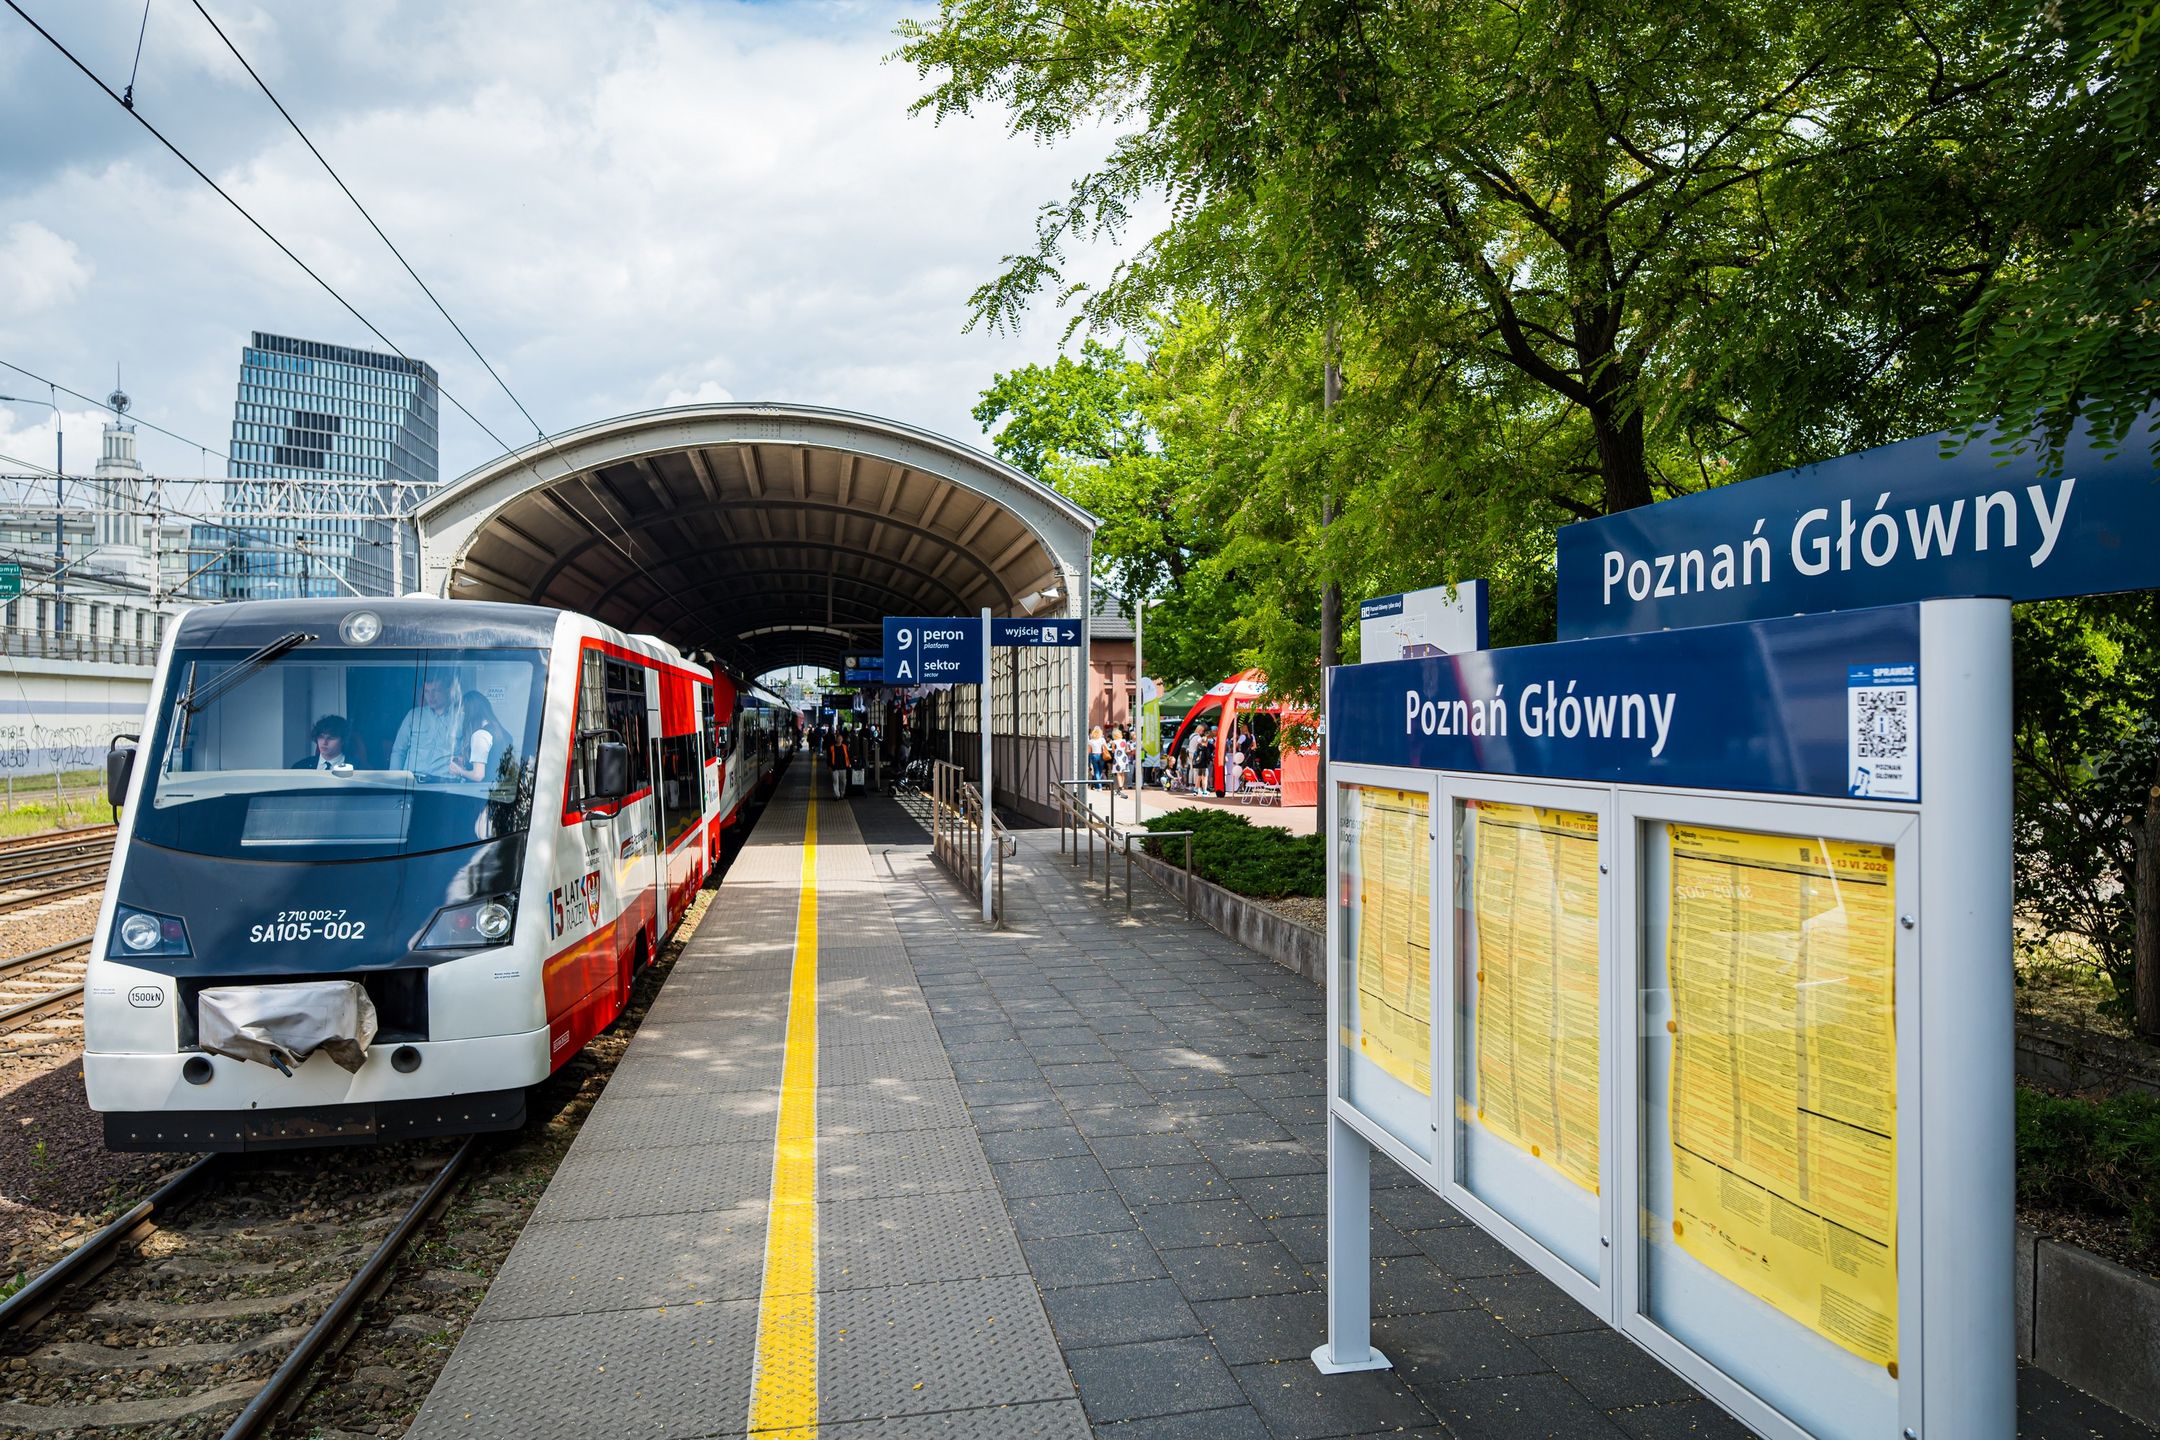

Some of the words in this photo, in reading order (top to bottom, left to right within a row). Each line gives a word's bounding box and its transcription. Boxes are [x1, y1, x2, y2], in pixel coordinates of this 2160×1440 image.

[1603, 517, 1771, 605] Poznań
[1790, 477, 2076, 577] Główny
[896, 628, 913, 650] 9
[923, 629, 964, 643] peron
[1005, 626, 1039, 638] wyjście
[923, 642, 950, 650] platform
[896, 659, 913, 679] A
[923, 659, 961, 671] sektor
[1406, 684, 1507, 736] Poznań
[1519, 679, 1676, 758] Główny
[1837, 859, 1847, 868] 13
[1850, 861, 1860, 870] VI
[1863, 863, 1889, 872] 2026
[277, 911, 286, 922] 2
[287, 910, 307, 922] 710
[308, 909, 347, 921] 002-7
[546, 886, 564, 941] 15
[564, 879, 580, 906] LAT
[566, 901, 588, 932] RAZEM
[249, 921, 366, 943] SA105-002
[131, 992, 161, 1002] 1500kN
